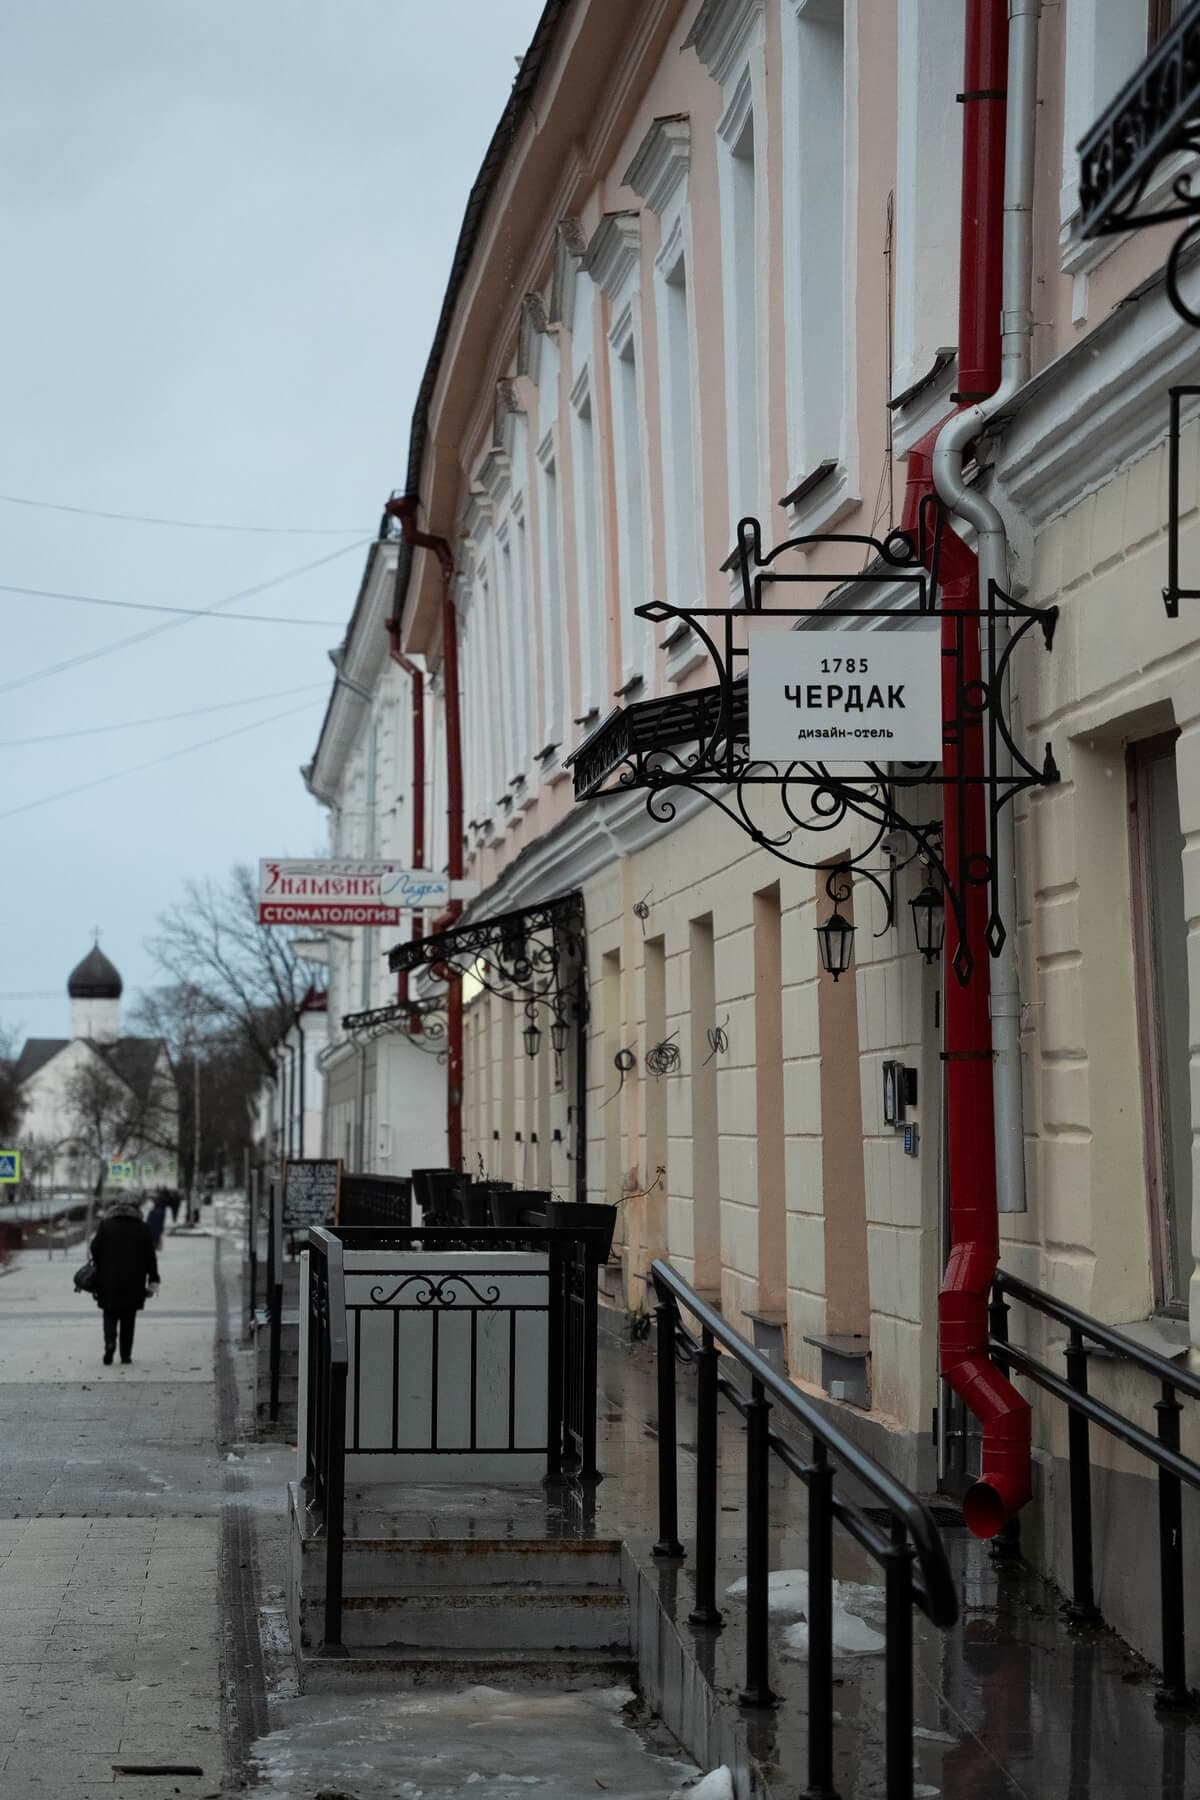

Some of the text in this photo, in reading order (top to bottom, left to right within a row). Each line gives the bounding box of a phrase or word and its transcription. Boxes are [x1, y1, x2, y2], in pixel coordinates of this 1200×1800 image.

[820, 658, 869, 673] 1785
[784, 685, 906, 712] ЧЕРДАК
[798, 727, 894, 741] дизайн-отель
[264, 863, 382, 895] Знаменк
[264, 906, 397, 923] СТОМАТОЛОГИЯ
